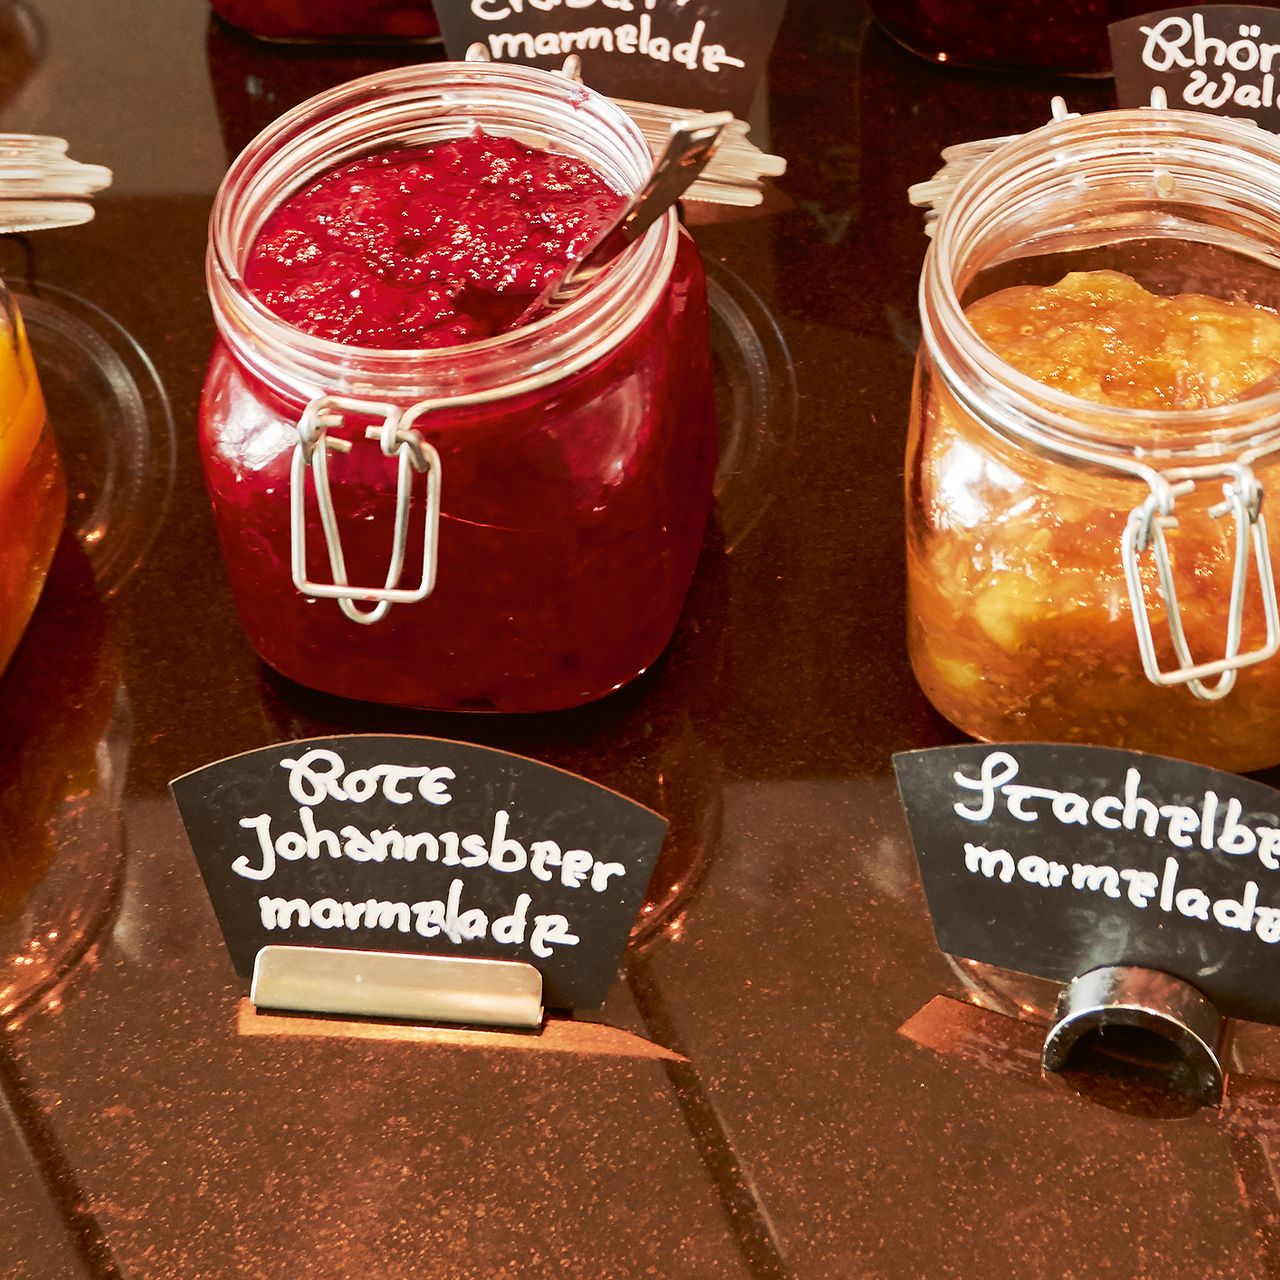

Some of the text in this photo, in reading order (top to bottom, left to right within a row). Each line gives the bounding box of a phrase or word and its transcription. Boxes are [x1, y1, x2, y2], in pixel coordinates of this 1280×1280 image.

[487, 13, 747, 73] marmelade
[230, 805, 627, 893] Johannisbeer
[258, 877, 581, 959] marmelade
